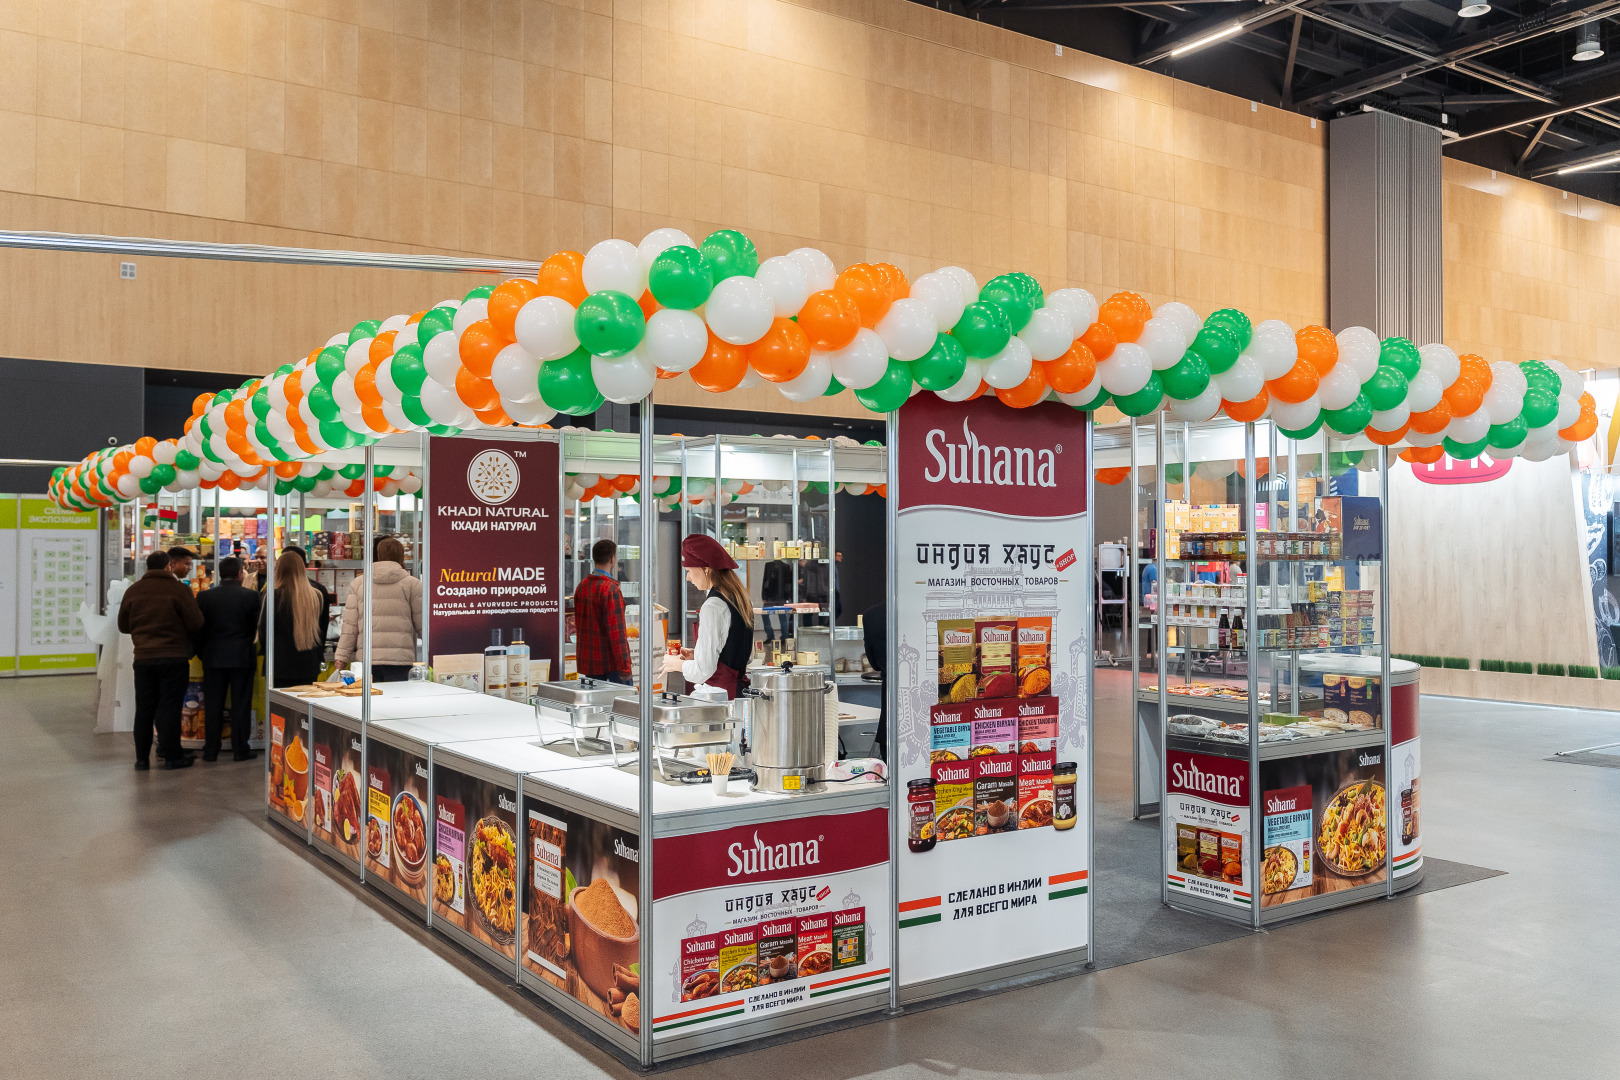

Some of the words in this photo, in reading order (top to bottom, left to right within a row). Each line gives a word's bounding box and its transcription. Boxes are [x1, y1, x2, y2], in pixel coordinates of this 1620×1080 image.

[438, 506, 481, 516] KHADI
[486, 507, 549, 518] NATURAL
[452, 521, 488, 532] КХАДИ
[491, 522, 536, 531] НАТУРАЛ
[1059, 553, 1074, 568] SHOP
[928, 578, 966, 586] МАГАЗИН
[971, 578, 1019, 586] ВОСТОЧНЫХ
[1025, 577, 1058, 585] ТОВАРОВ
[437, 586, 487, 597] Создано
[491, 584, 547, 597] природой
[946, 632, 970, 644] Suhana
[984, 629, 1009, 642] Suhana
[1020, 630, 1044, 642] Suhana
[975, 705, 1002, 719] Suhana
[1019, 703, 1044, 716] Suhana
[933, 710, 961, 723] Suhana
[1022, 756, 1051, 772] Suhana
[1359, 752, 1381, 767] Suhana
[980, 758, 1012, 775] Suhana
[937, 767, 970, 782] Suhana
[977, 782, 997, 790] Garam
[1019, 779, 1035, 787] Meat
[1268, 795, 1296, 813] Suhana
[1268, 815, 1292, 826] VEGETABLE
[537, 844, 559, 865] Suhana
[614, 837, 639, 862] Suhana
[948, 885, 996, 904] СДЕЛАНО
[999, 884, 1005, 894] В
[1008, 877, 1042, 893] ИНДИИ
[953, 906, 974, 921] ДЛЯ
[976, 900, 1008, 915] ВСЕГО
[1011, 895, 1037, 908] МИРА
[733, 916, 758, 925] МАГАЗИН
[760, 909, 793, 920] ВОСТОЧНЫХ
[796, 905, 819, 913] ТОВАРОВ
[835, 912, 860, 925] Suhana
[763, 922, 792, 937] Suhana
[801, 918, 827, 931] Suhana
[725, 929, 754, 945] Suhana
[686, 940, 715, 953] Suhana
[760, 941, 779, 949] Garam
[749, 992, 777, 1003] СДЕЛАНО
[784, 986, 806, 995] ИНДИИ
[752, 1004, 764, 1012] ДЛЯ
[766, 1000, 785, 1008] ВСЕГО
[787, 995, 803, 1004] МИРА
